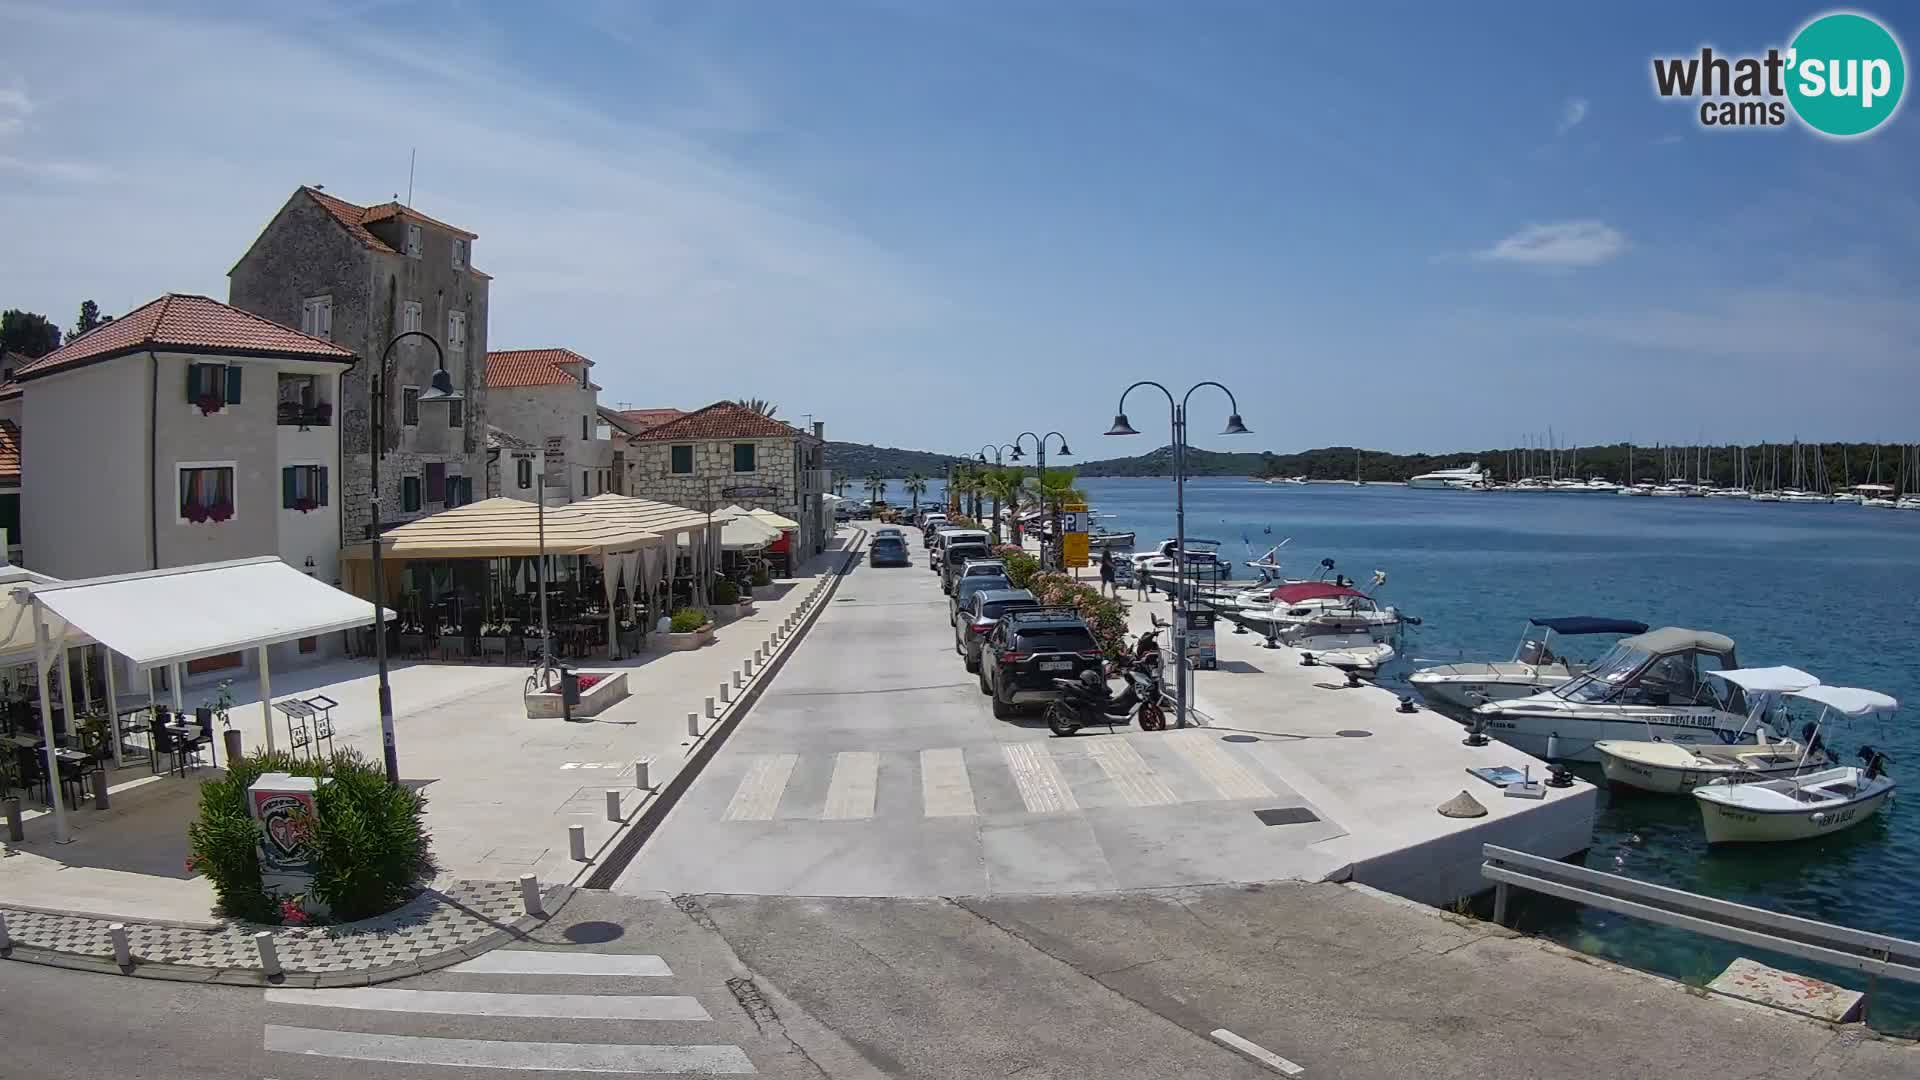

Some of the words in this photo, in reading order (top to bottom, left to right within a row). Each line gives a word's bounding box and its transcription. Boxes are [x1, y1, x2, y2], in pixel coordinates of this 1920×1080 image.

[1065, 514, 1076, 530] P
[1670, 715, 1690, 725] RENT
[1698, 715, 1716, 728] BOAT
